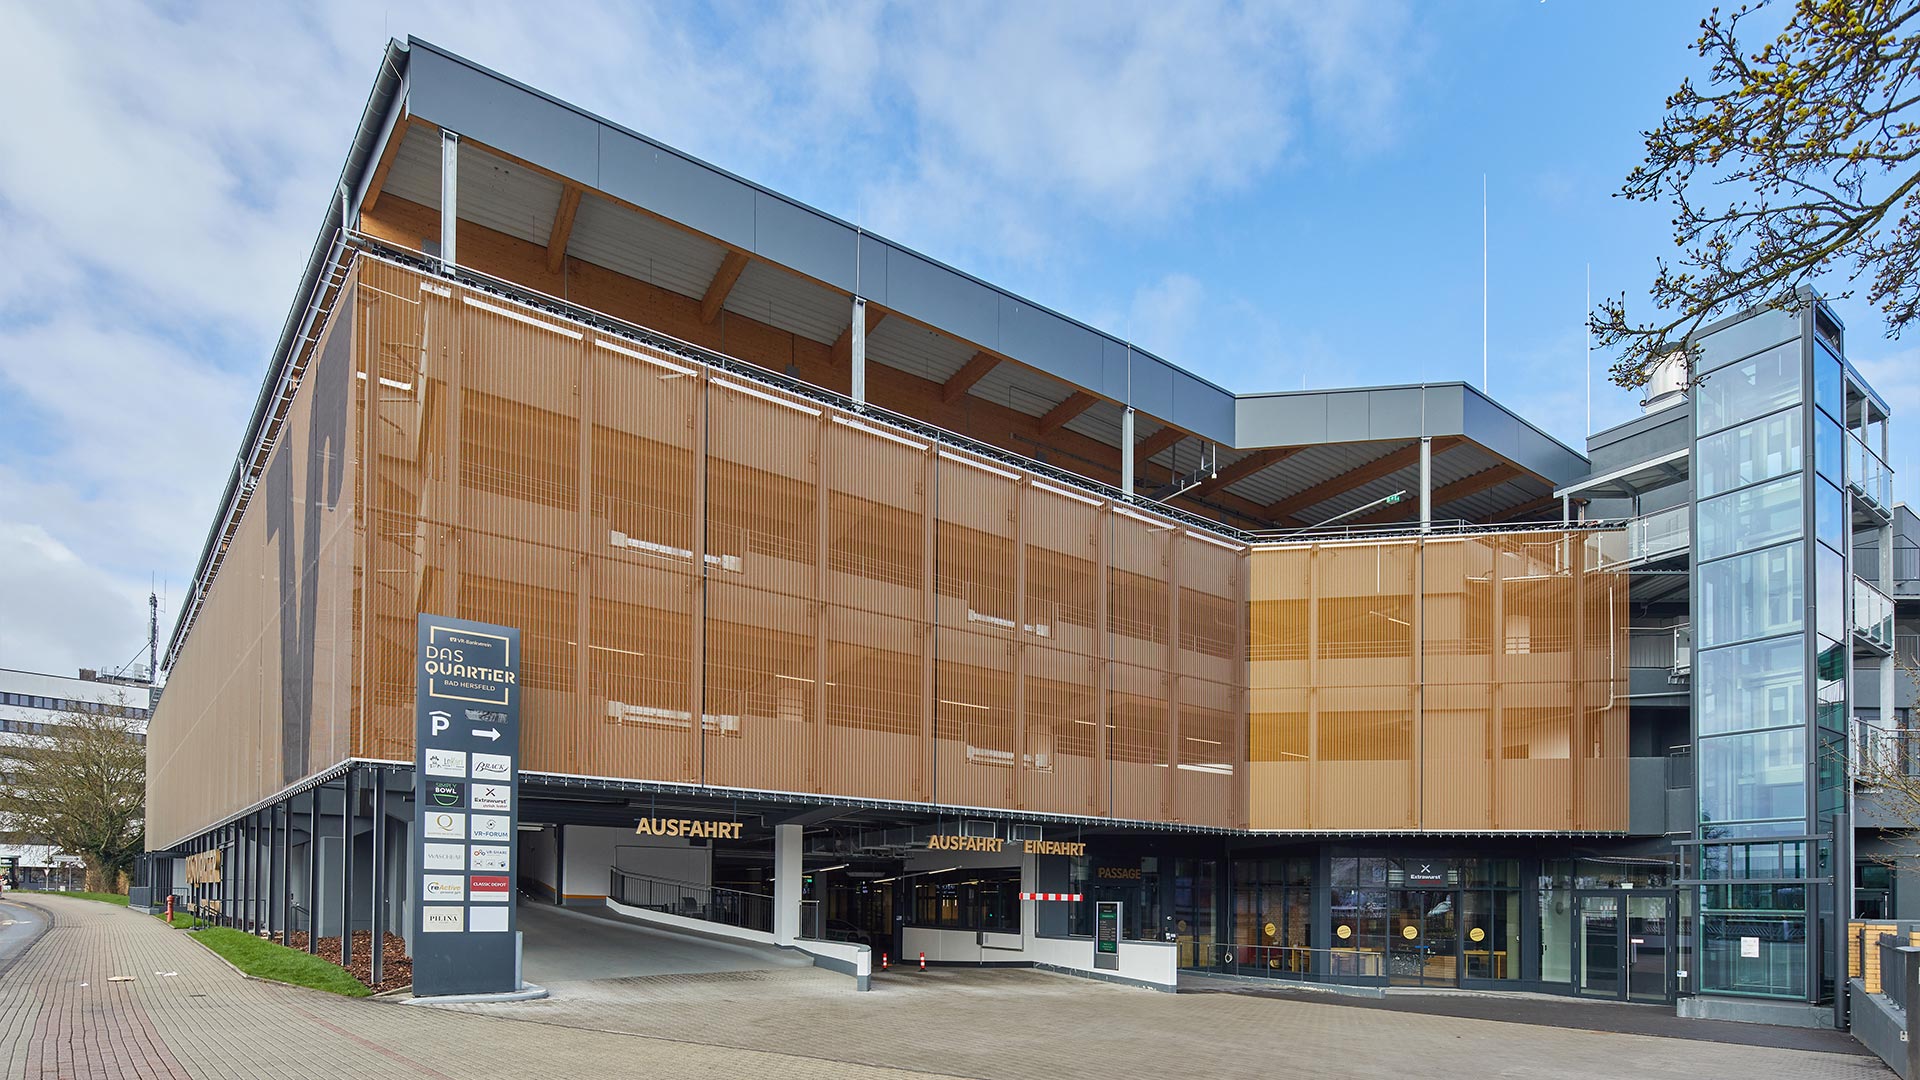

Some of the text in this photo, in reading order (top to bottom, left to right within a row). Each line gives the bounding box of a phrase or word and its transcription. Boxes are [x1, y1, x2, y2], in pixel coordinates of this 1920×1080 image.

[426, 646, 464, 663] DAS
[460, 682, 496, 692] HERSFELD
[431, 715, 450, 736] P
[436, 814, 454, 832] Q
[636, 817, 743, 840] AUSFAHRT
[928, 834, 1086, 857] AUSFAHRT EINFAHRT
[1098, 867, 1142, 880] PASSAGE
